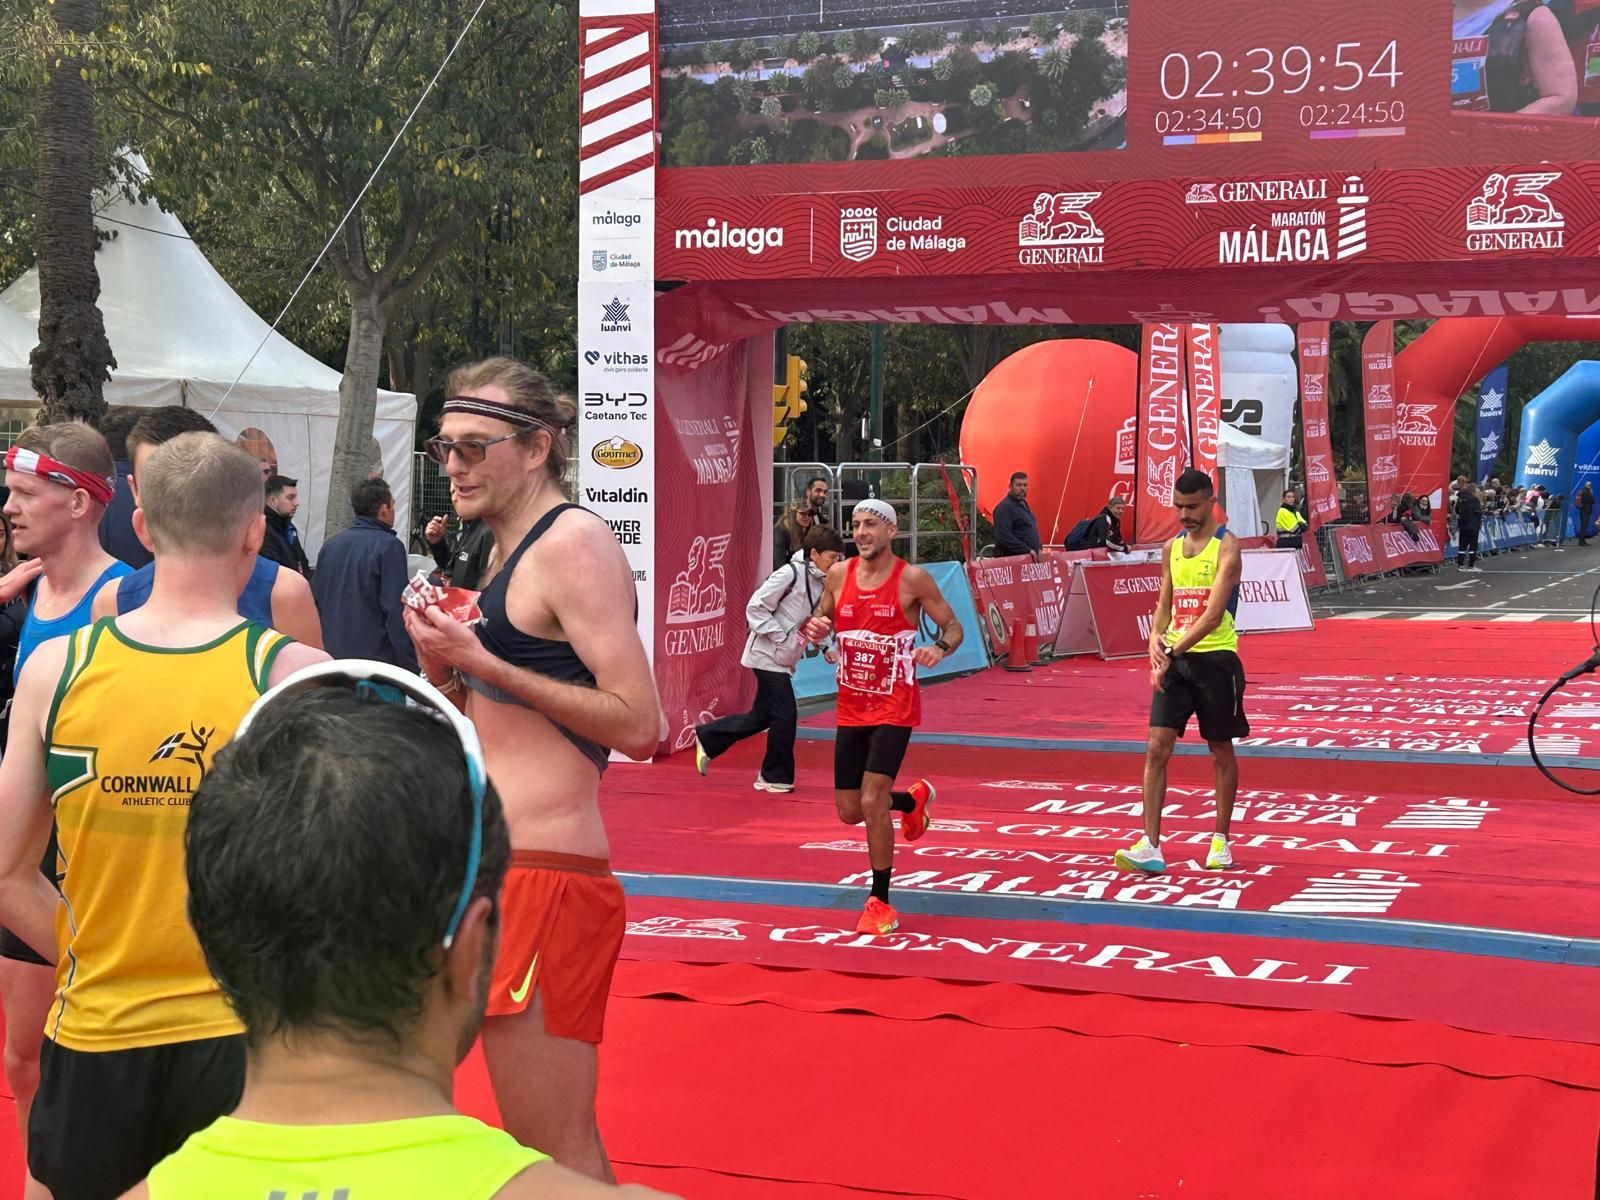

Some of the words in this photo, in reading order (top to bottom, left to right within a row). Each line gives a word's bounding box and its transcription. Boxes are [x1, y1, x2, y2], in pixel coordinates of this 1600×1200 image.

[1160, 40, 1404, 100] 02:39:54
[1155, 106, 1262, 133] 02:34:50
[1299, 101, 1405, 126] 02:24:50
[1219, 179, 1328, 203] GENERALI
[886, 216, 942, 232] Ciudad
[1271, 209, 1326, 227] MARATÓN
[886, 235, 905, 250] de
[909, 234, 966, 252] Málaga
[1218, 224, 1330, 264] MÁLAGA
[1466, 230, 1564, 251] GENERALI
[1018, 246, 1104, 265] GENERALI
[601, 323, 631, 332] luanvi
[604, 351, 648, 365] vithas
[585, 393, 648, 406] BYD
[585, 411, 628, 420] Caetano
[630, 411, 648, 420] Tec
[597, 449, 637, 459] Gourmet
[1525, 464, 1559, 477] luanvi
[586, 487, 648, 503] Vitaldin
[1178, 598, 1199, 608] 1870
[854, 651, 876, 664] 387
[101, 775, 195, 794] CORNWALL
[122, 796, 165, 806] ATHLETIC
[168, 797, 192, 806] CLUB
[768, 925, 1370, 985] GENERALI
